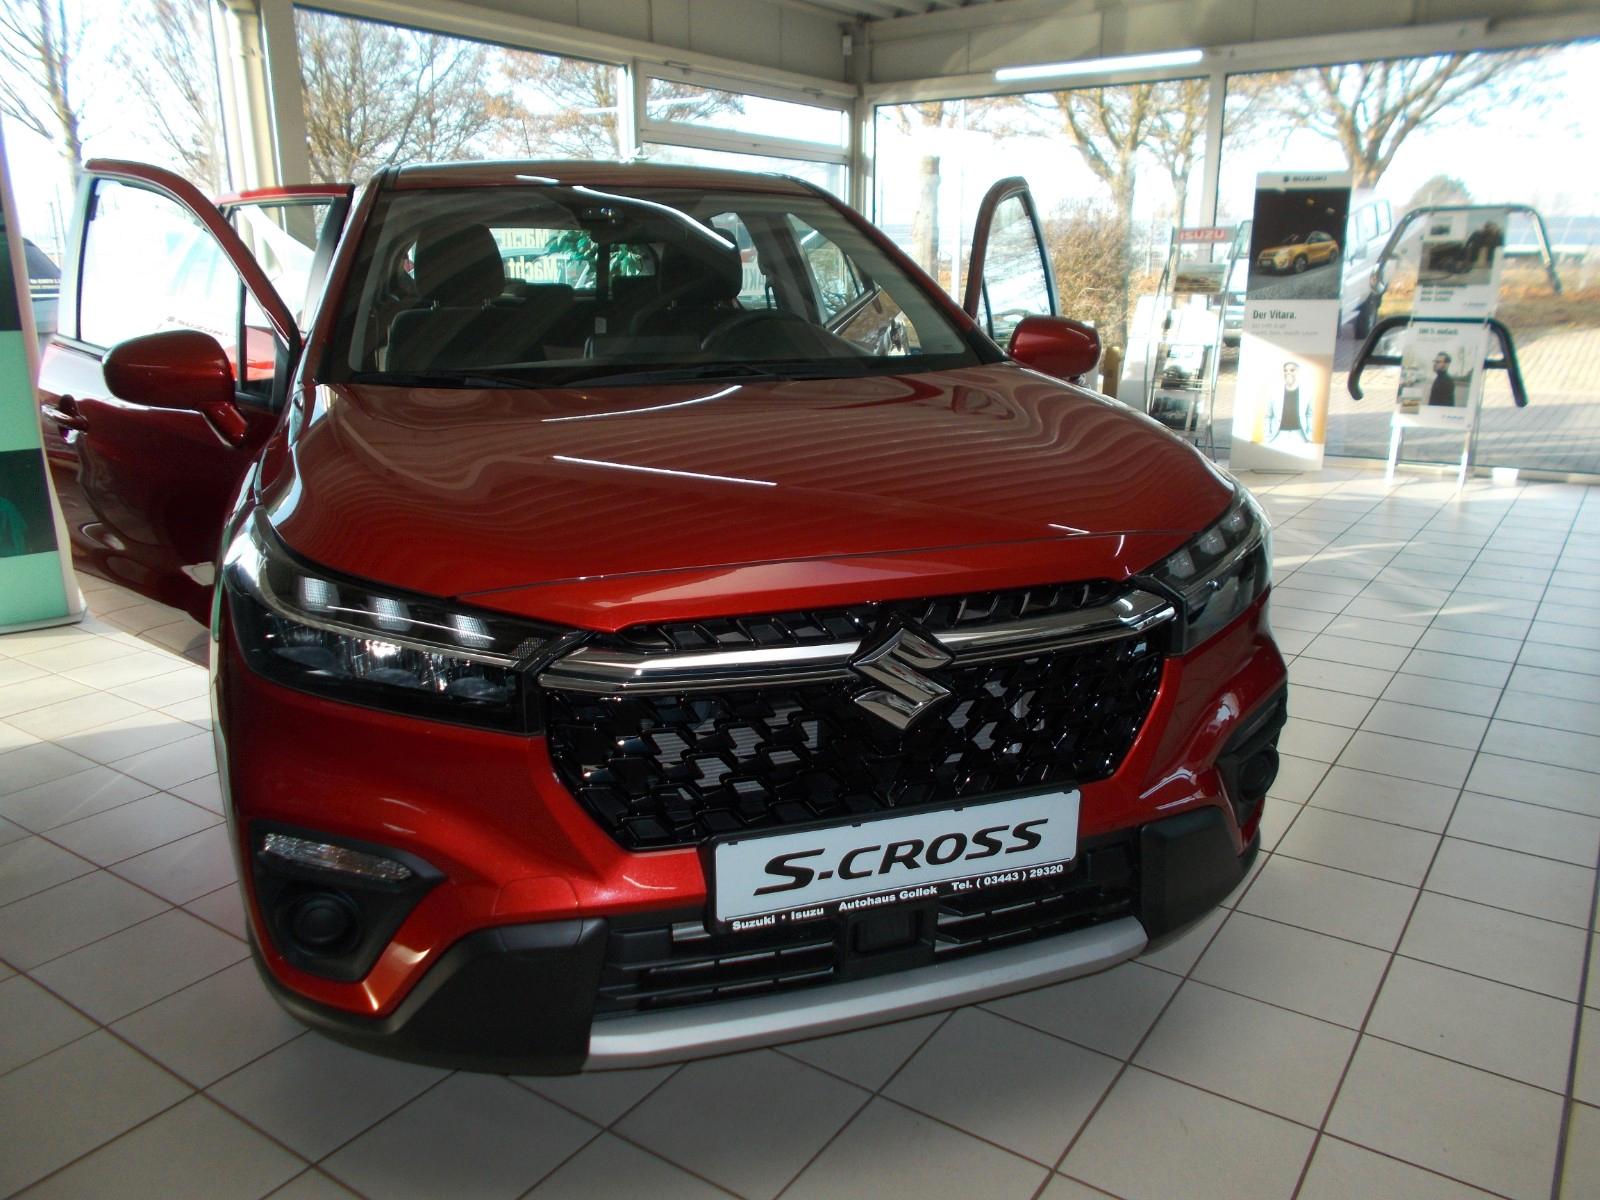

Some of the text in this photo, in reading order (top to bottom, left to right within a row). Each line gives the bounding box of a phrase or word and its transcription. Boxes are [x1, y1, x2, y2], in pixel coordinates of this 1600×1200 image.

[1179, 229, 1226, 241] ISUZU
[1252, 308, 1297, 320] Der Vitara.
[753, 818, 1048, 896] S-CROSS
[732, 914, 775, 930] Suzuki
[791, 907, 824, 920] Isuzu
[839, 893, 896, 911] Autohaus
[899, 885, 937, 899] Gollek
[951, 880, 973, 890] Tel.
[1029, 864, 1064, 878] 29320
